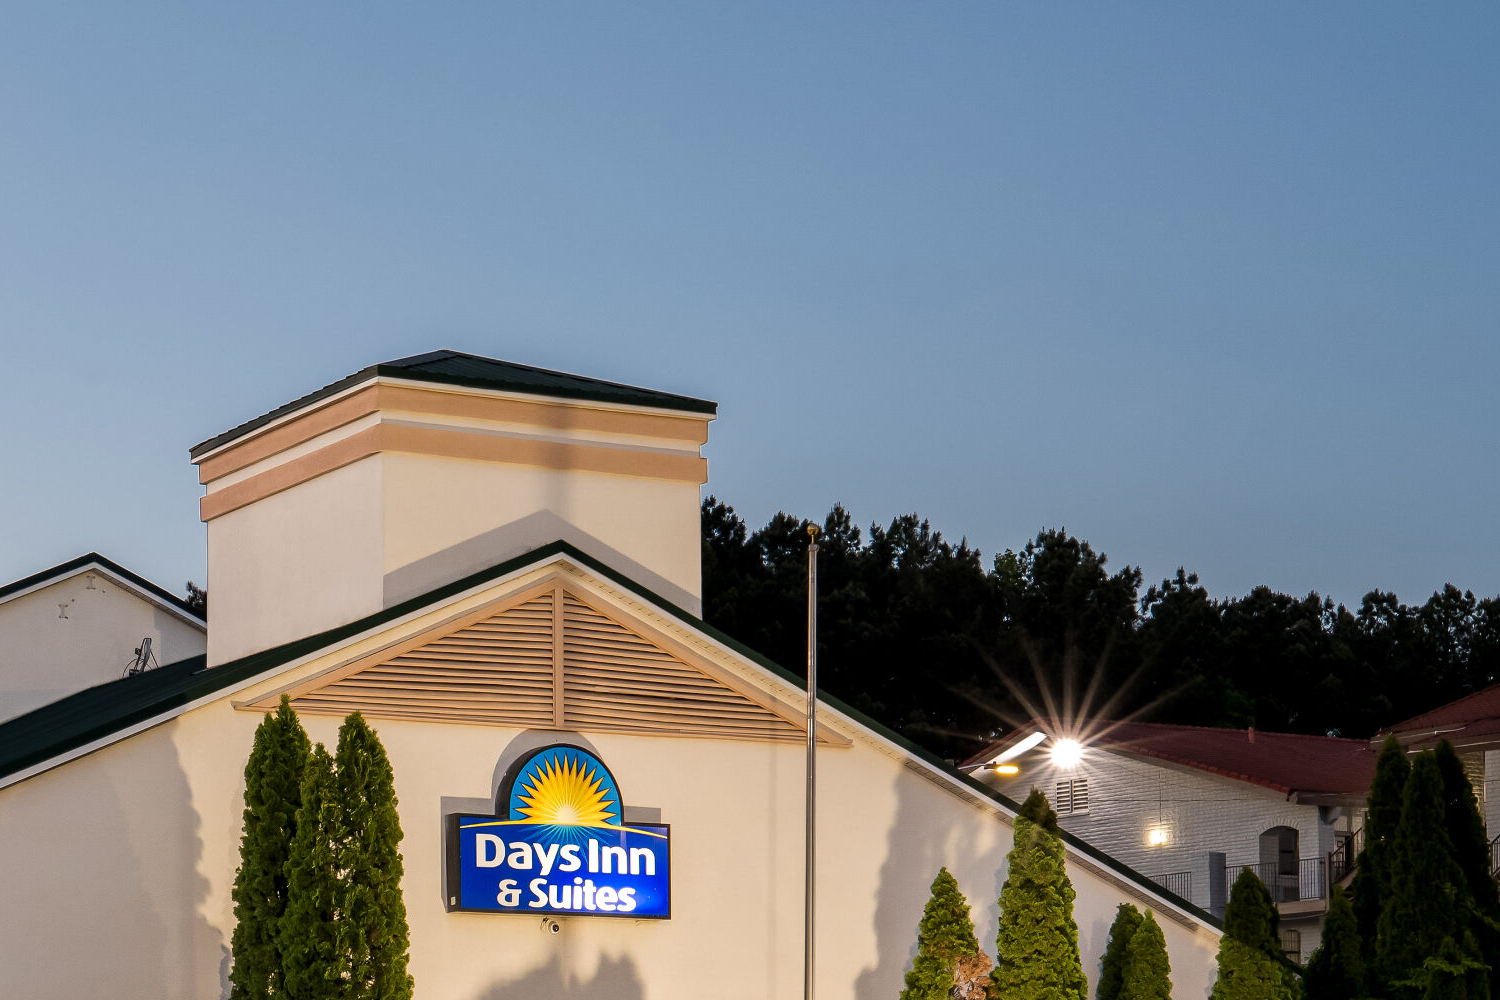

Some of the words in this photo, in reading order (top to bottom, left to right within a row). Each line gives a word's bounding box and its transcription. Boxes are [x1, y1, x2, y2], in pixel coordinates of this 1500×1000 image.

[475, 833, 582, 876] Days
[588, 838, 656, 876] Inn
[496, 878, 522, 907] &
[528, 877, 637, 912] Suites
